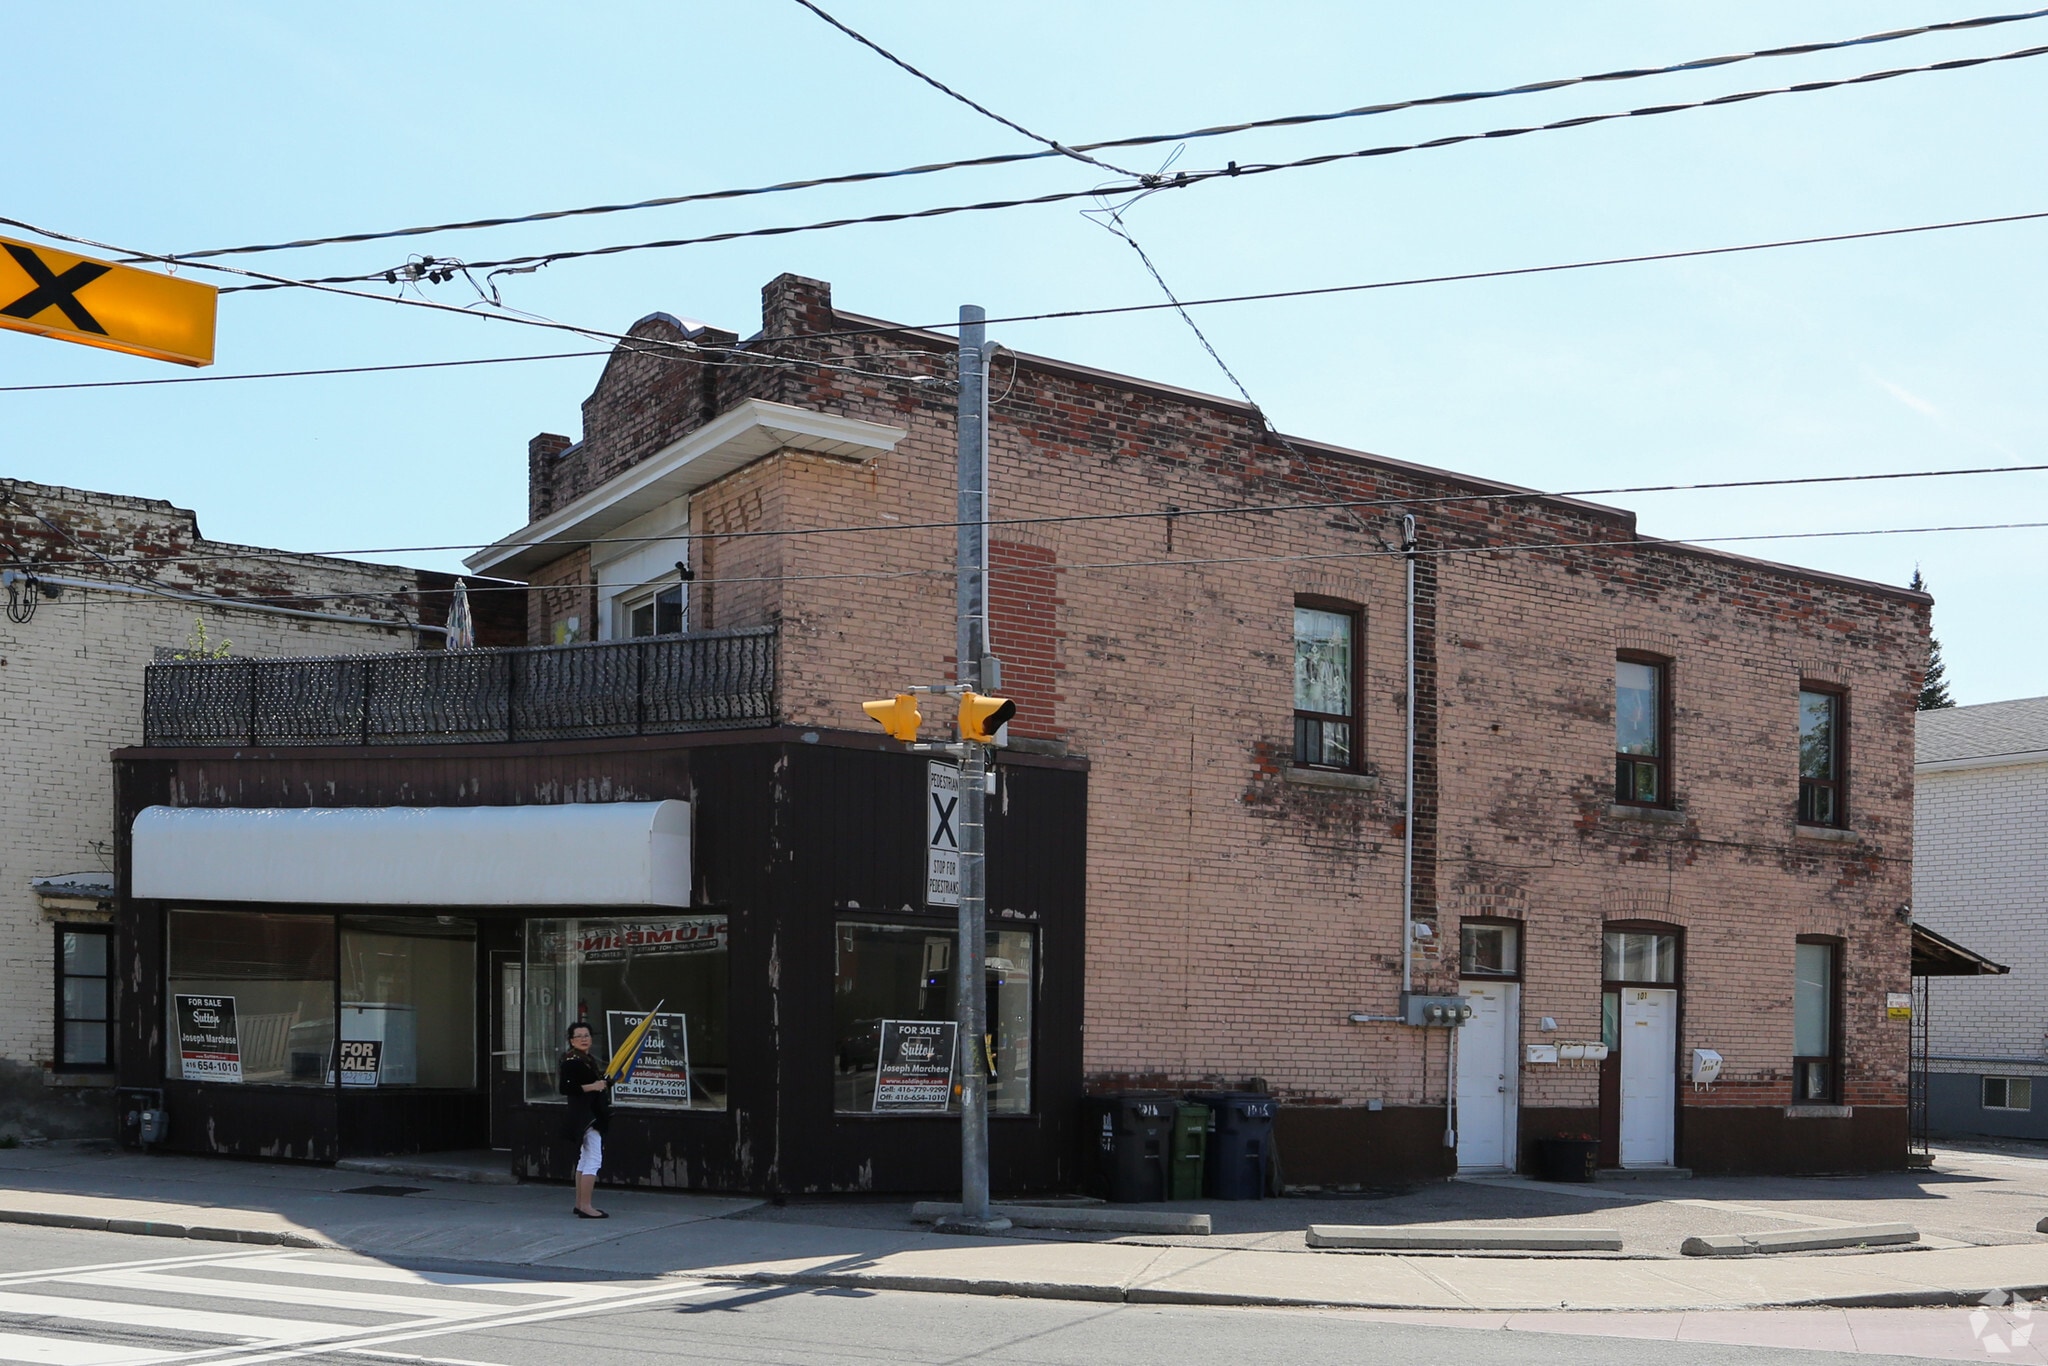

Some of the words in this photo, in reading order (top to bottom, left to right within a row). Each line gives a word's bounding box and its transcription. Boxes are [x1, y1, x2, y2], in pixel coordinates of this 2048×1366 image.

[931, 773, 958, 791] PEDESTRIAN
[934, 859, 945, 874] STOP
[947, 861, 956, 875] FOR
[929, 878, 959, 894] PEDESTRIANS
[188, 998, 203, 1006] FOR
[204, 999, 222, 1007] SALE
[193, 1011, 220, 1024] Sutton
[651, 1019, 668, 1027] ALE
[899, 1026, 917, 1034] FOR
[919, 1026, 941, 1035] SALE
[182, 1033, 205, 1044] Joseph
[206, 1034, 236, 1044] Marchese
[341, 1042, 374, 1056] FOR
[900, 1041, 935, 1056] Sutton
[198, 1061, 238, 1072] 654-1010
[645, 1056, 684, 1067] Marchese
[882, 1064, 910, 1074] Joseph
[912, 1064, 949, 1073] Marchese
[633, 1078, 685, 1087] 416-779-9299
[632, 1086, 686, 1096] 416-654-1010
